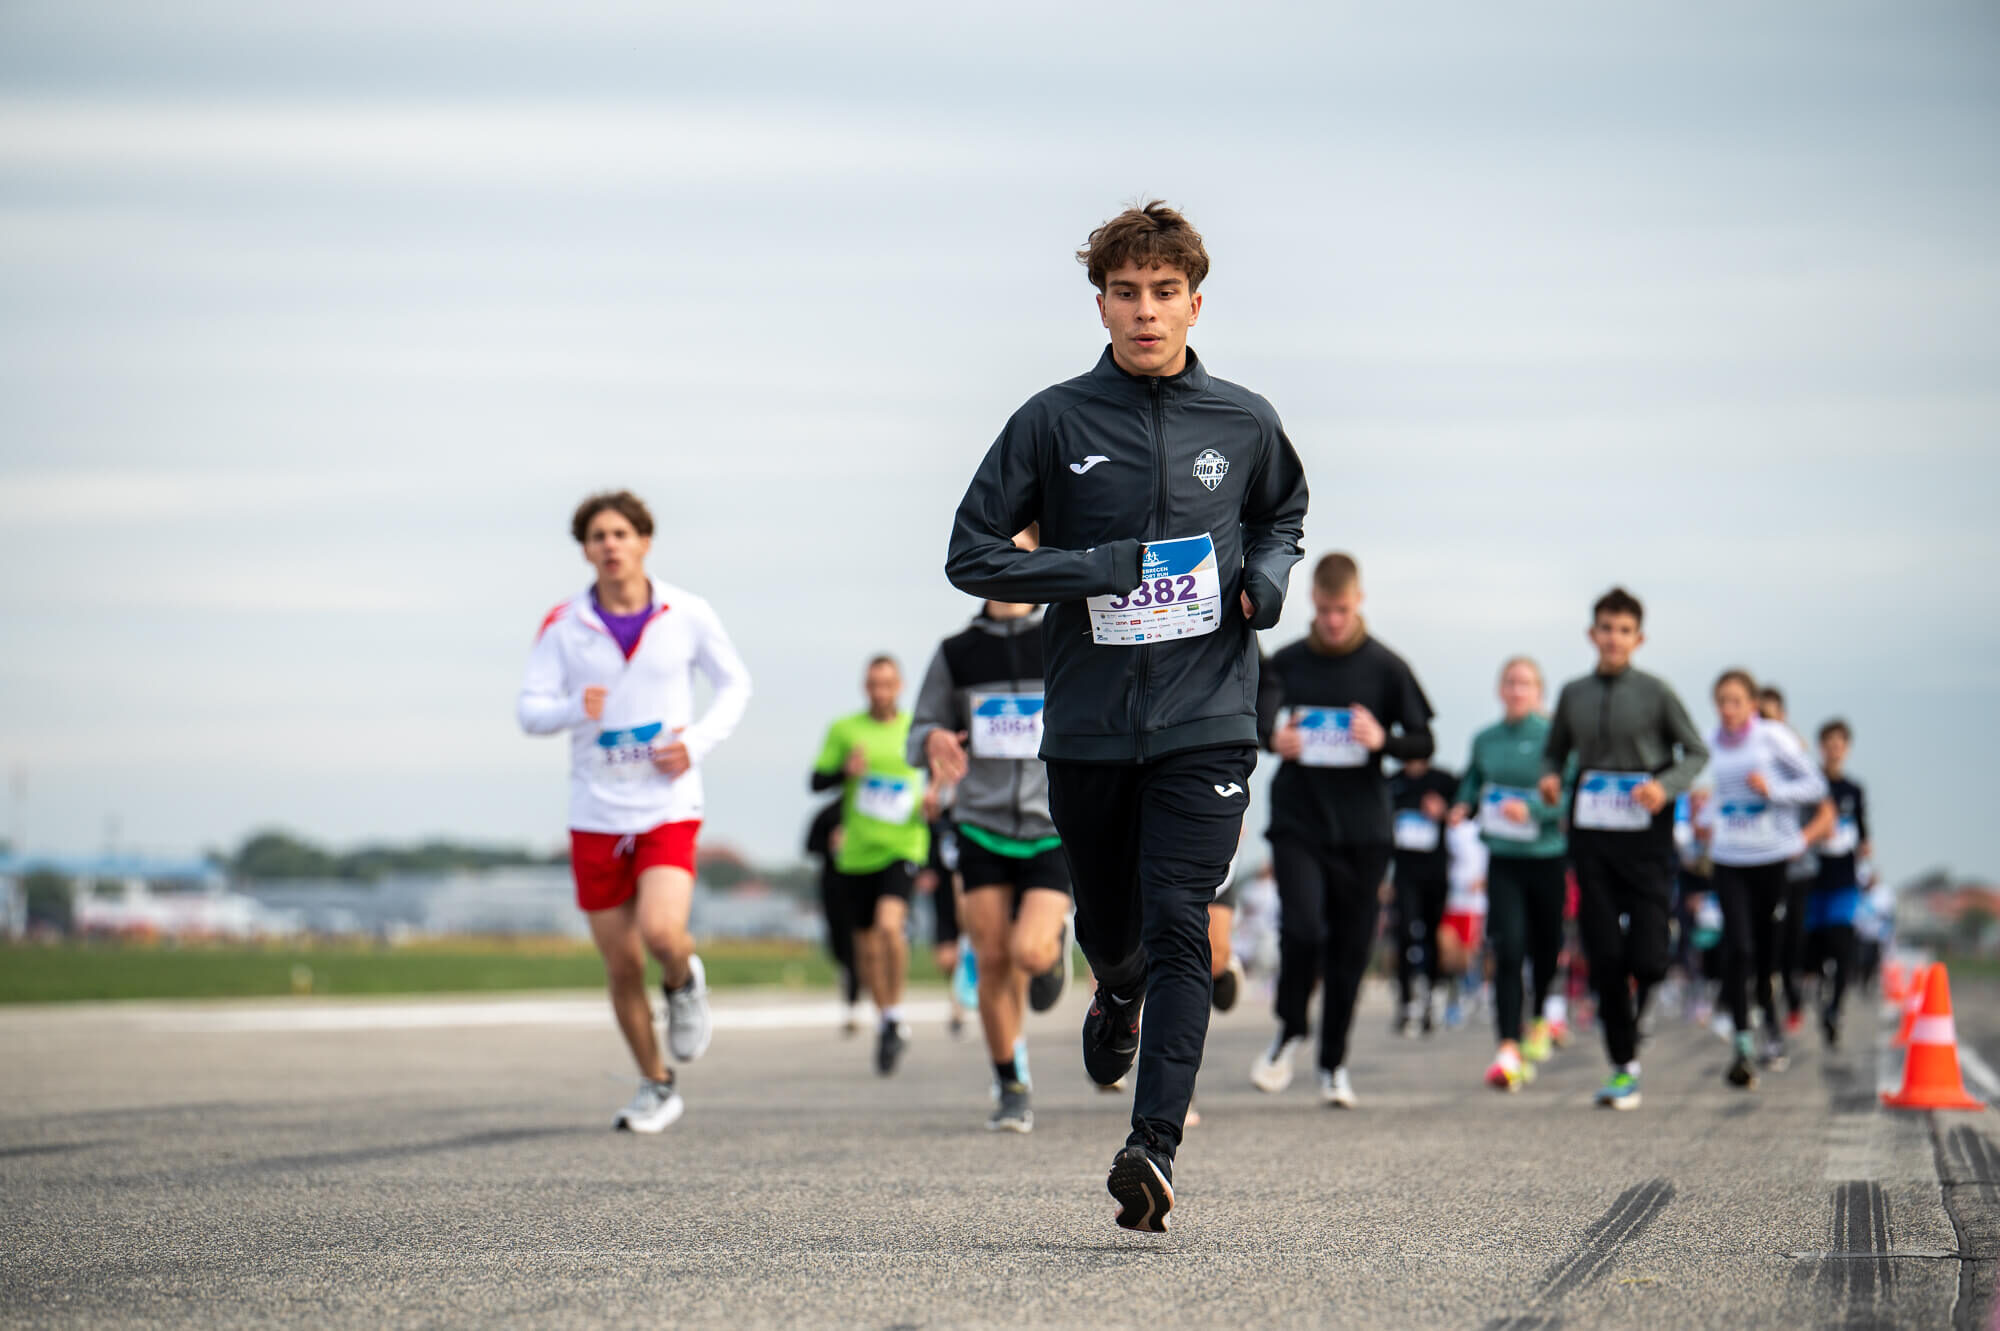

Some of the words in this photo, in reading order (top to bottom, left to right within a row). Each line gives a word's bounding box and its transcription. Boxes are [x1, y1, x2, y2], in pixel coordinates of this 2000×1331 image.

[1194, 464, 1213, 475] Filo
[1216, 463, 1228, 474] SE
[1142, 566, 1168, 574] EBRECEN
